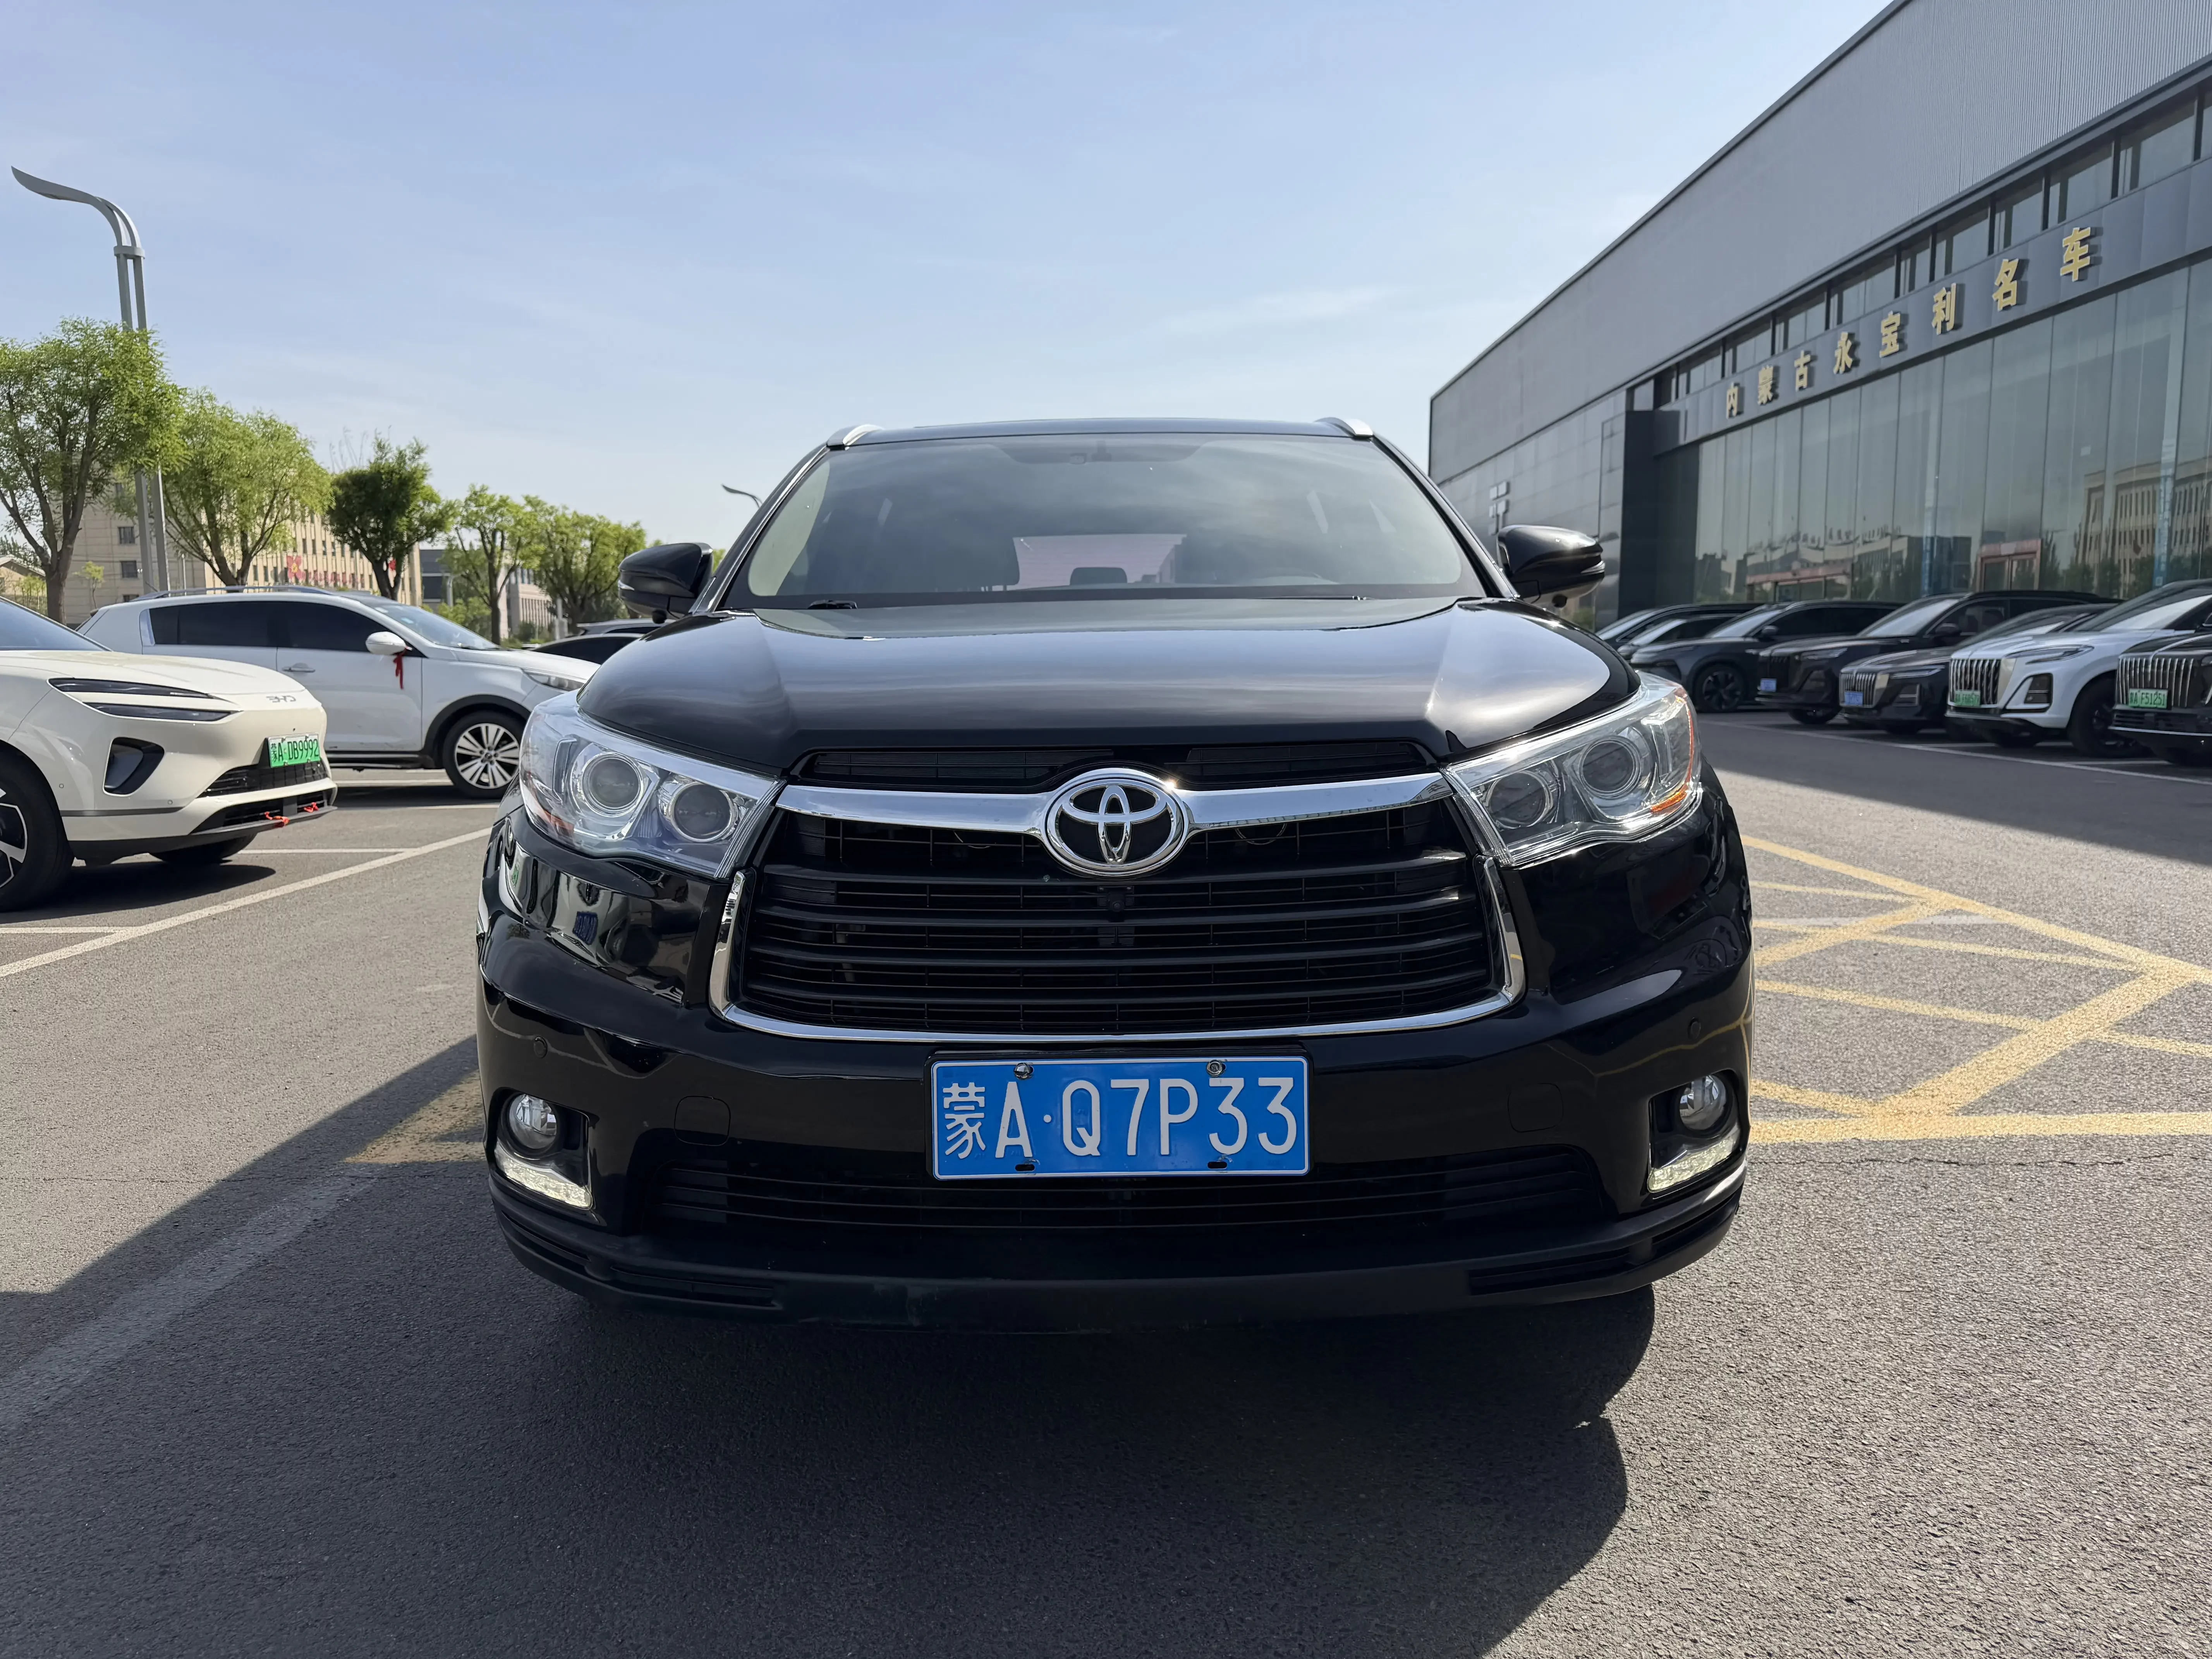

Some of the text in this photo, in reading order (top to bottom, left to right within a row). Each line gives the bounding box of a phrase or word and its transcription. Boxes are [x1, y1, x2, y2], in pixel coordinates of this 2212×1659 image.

[1726, 227, 2091, 419] 内蒙古永宝利名车
